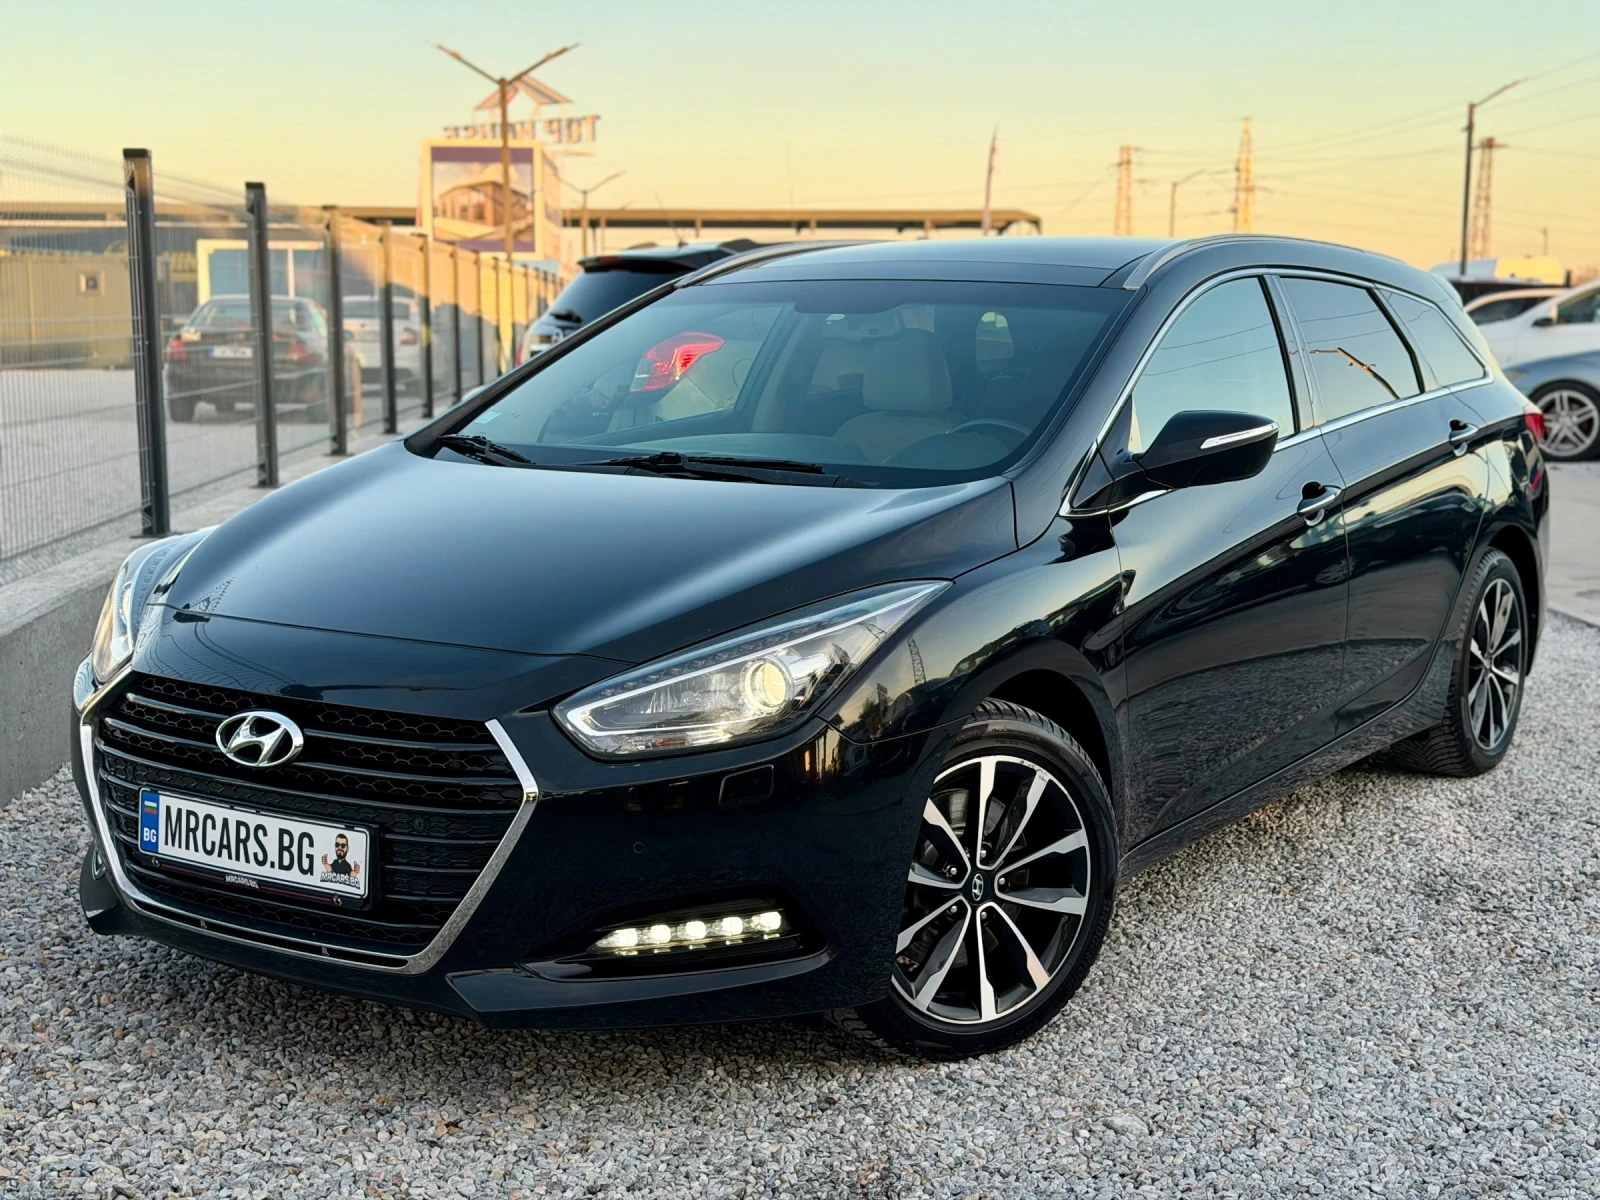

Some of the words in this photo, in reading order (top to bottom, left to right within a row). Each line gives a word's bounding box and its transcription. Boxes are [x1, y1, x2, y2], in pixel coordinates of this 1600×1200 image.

[143, 827, 157, 843] BG
[164, 805, 315, 876] MRCARS.BG
[320, 871, 361, 890] MRCARS.BG
